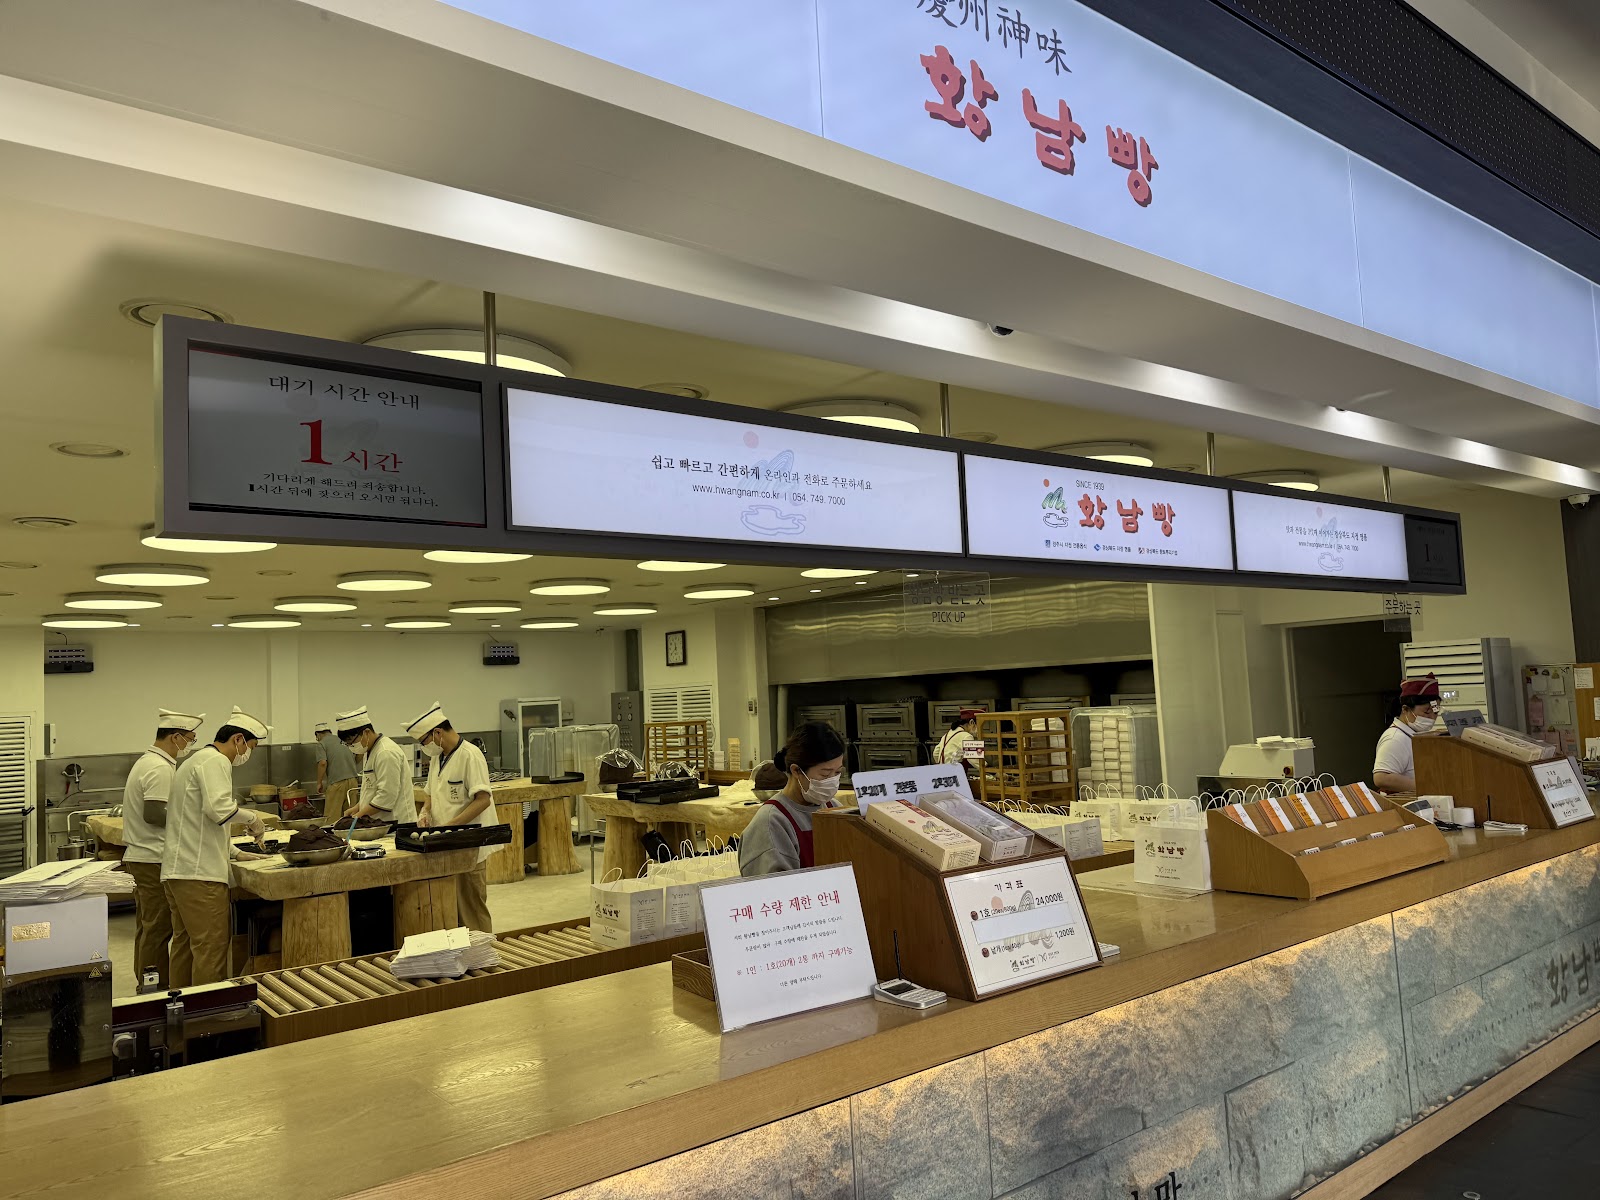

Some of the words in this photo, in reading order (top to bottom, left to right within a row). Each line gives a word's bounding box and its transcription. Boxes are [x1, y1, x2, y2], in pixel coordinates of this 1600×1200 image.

[920, 45, 1160, 208] 황남빵
[269, 376, 313, 395] 대기
[325, 383, 370, 403] 시간
[378, 390, 420, 410] 안내
[300, 419, 332, 465] 1
[343, 449, 403, 473] 시간
[263, 473, 315, 485] 기다리게
[651, 455, 675, 470] 쉽고
[679, 458, 714, 474] 빠르고
[717, 463, 760, 480] 간편하게
[764, 469, 800, 484] 온라인과
[803, 473, 829, 487] 전화로
[831, 476, 873, 491] 주문하세요
[288, 487, 312, 497] 뒤에
[360, 494, 395, 503] 오시면
[692, 484, 780, 500] www.hwangnam.co.kr
[828, 495, 846, 505] 7000
[1075, 480, 1092, 490] SINCE
[1093, 482, 1105, 491] 1939
[1078, 493, 1176, 537] 황남빵
[974, 584, 986, 605] 곳
[932, 611, 952, 623] PICK
[954, 611, 966, 623] UP
[1385, 599, 1413, 614] 주문하는
[1413, 600, 1422, 615] 곳
[994, 880, 1024, 892] 가격표
[729, 904, 754, 923] 구매
[760, 900, 783, 917] 수량
[789, 895, 812, 912] 제한
[817, 889, 841, 907] 안내
[979, 908, 991, 918] 1호
[1035, 891, 1064, 905] 24,000원
[1055, 927, 1075, 939] 1,200원
[746, 965, 757, 975] 1인
[812, 951, 825, 961] 까지
[828, 946, 853, 958] 구매가능
